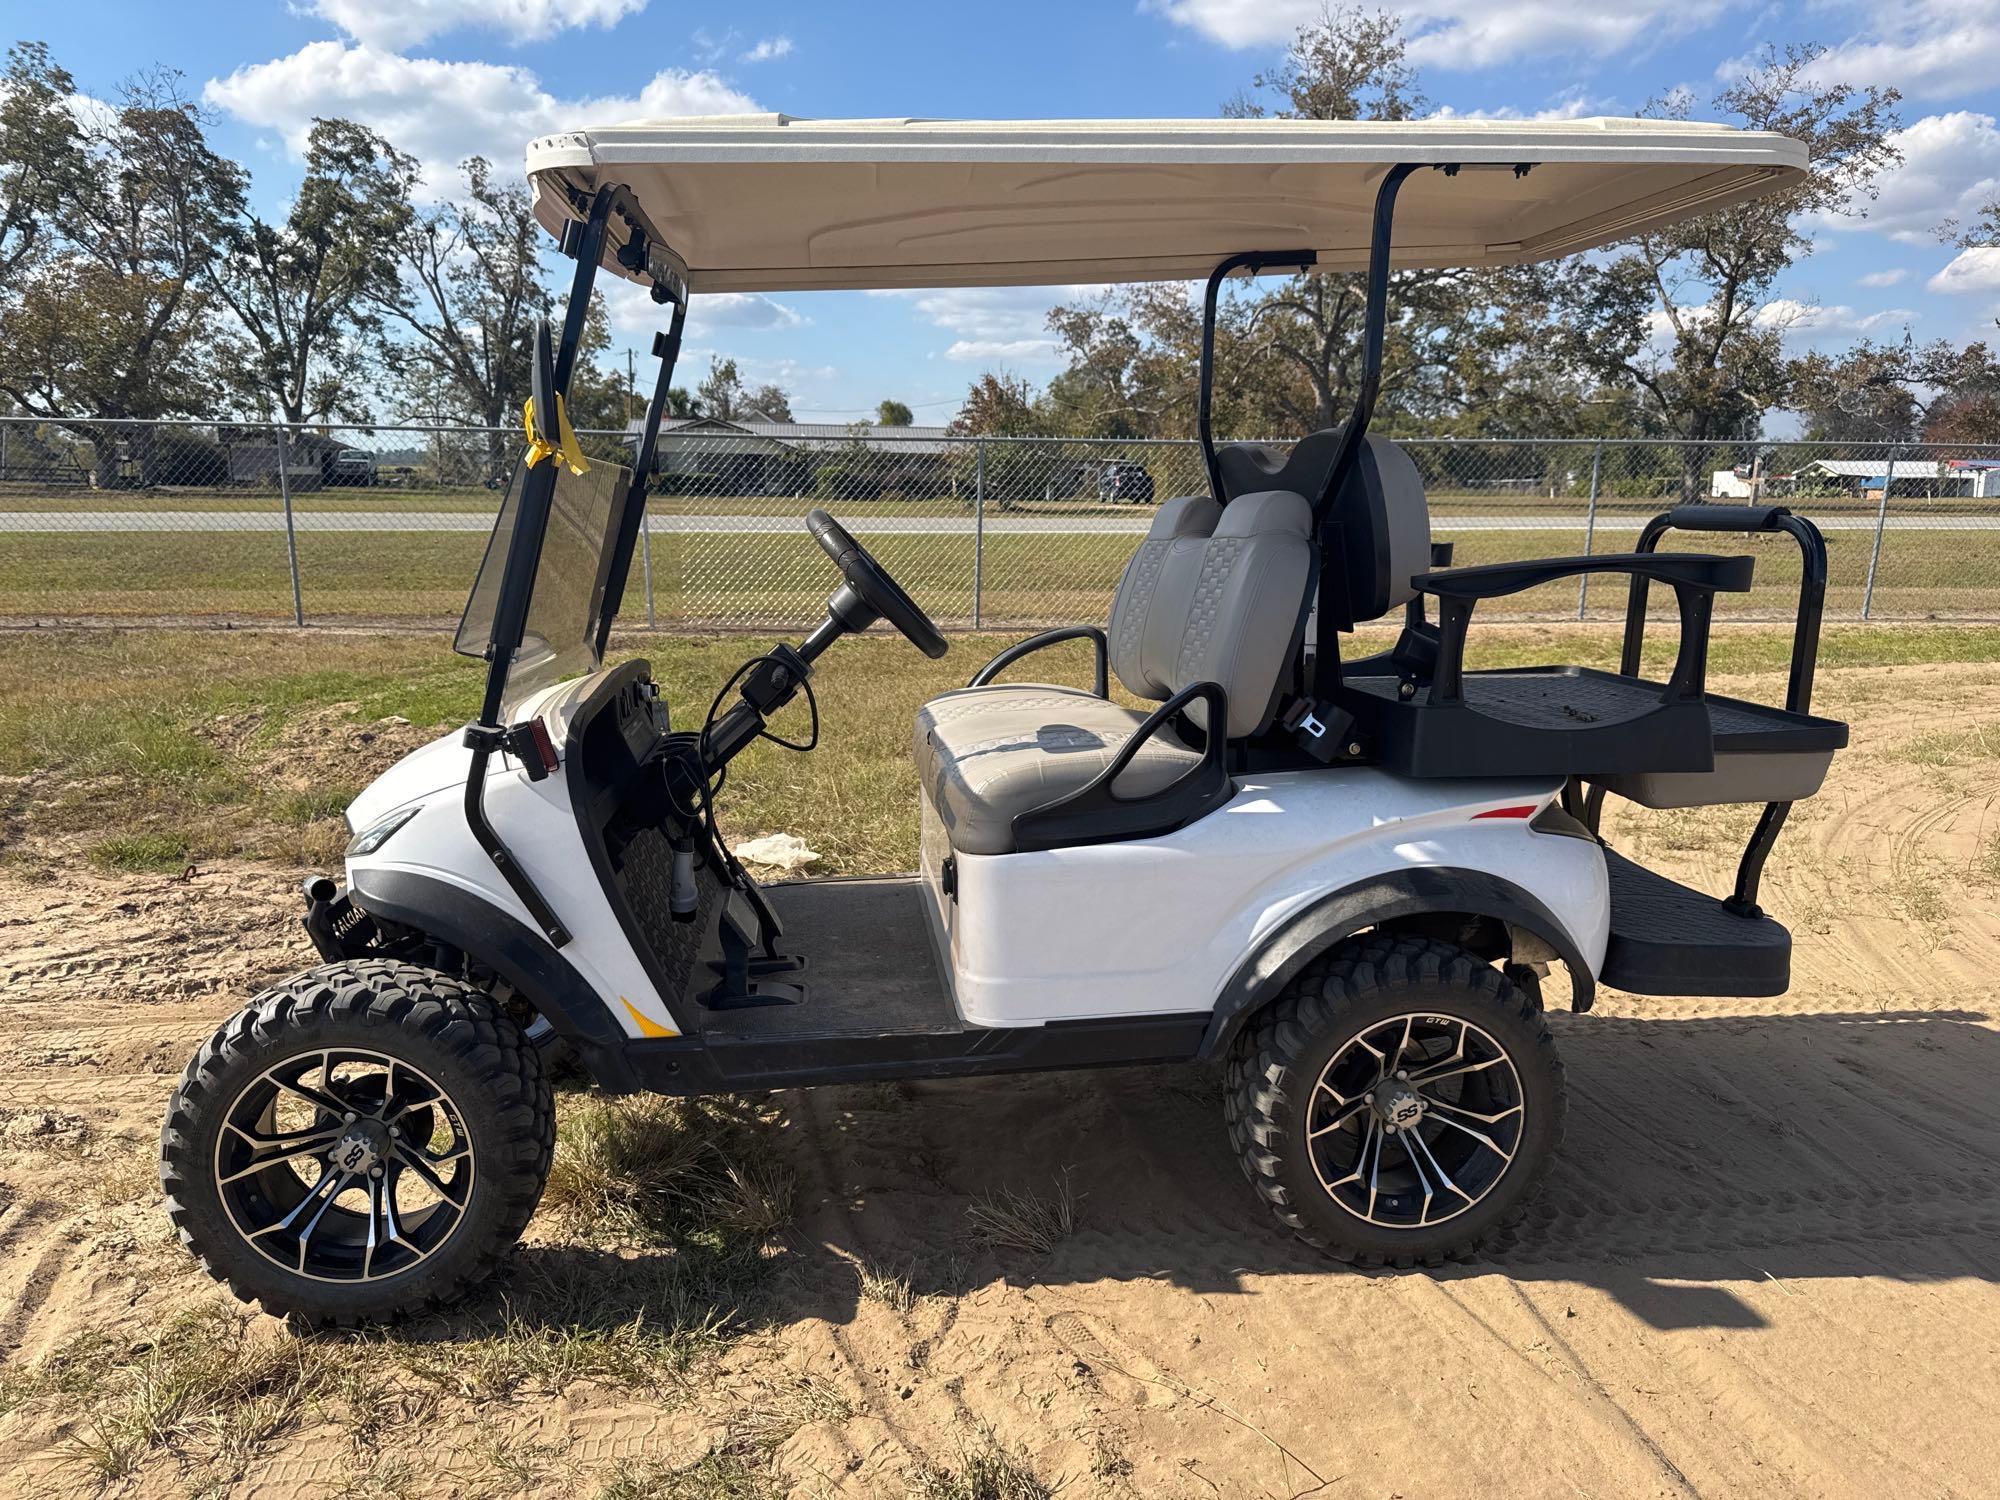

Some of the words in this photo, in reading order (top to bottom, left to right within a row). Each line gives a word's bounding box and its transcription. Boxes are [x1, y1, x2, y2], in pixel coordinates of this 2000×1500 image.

[1426, 1017, 1450, 1026] GTW
[1397, 1103, 1417, 1122] SS
[449, 1114, 465, 1137] GTW
[344, 1144, 364, 1169] SS
